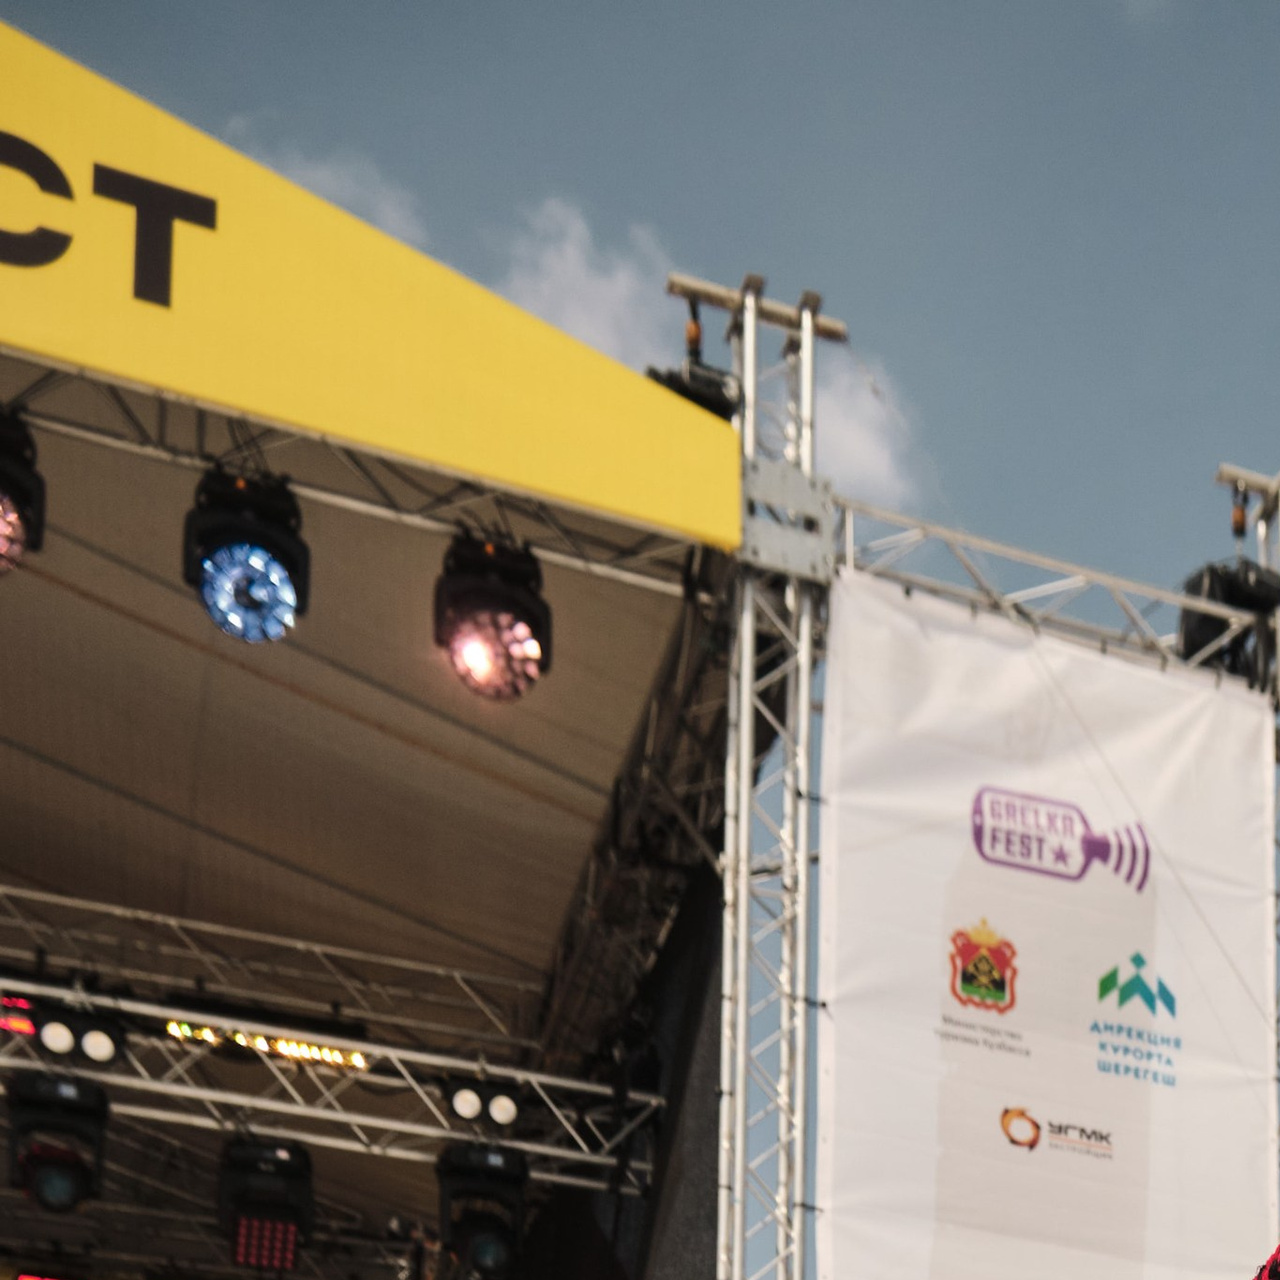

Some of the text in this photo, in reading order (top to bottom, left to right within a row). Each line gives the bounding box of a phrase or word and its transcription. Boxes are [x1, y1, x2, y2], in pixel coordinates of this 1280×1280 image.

[990, 799, 1075, 838] GRELKA
[990, 826, 1046, 862] FEST
[1089, 1020, 1182, 1050] ДИРЕКЦИЯ
[1098, 1041, 1174, 1067] КУРОРТА
[1096, 1058, 1177, 1087] ШЕРЕГЕШ
[1048, 1119, 1112, 1146] УГМК
